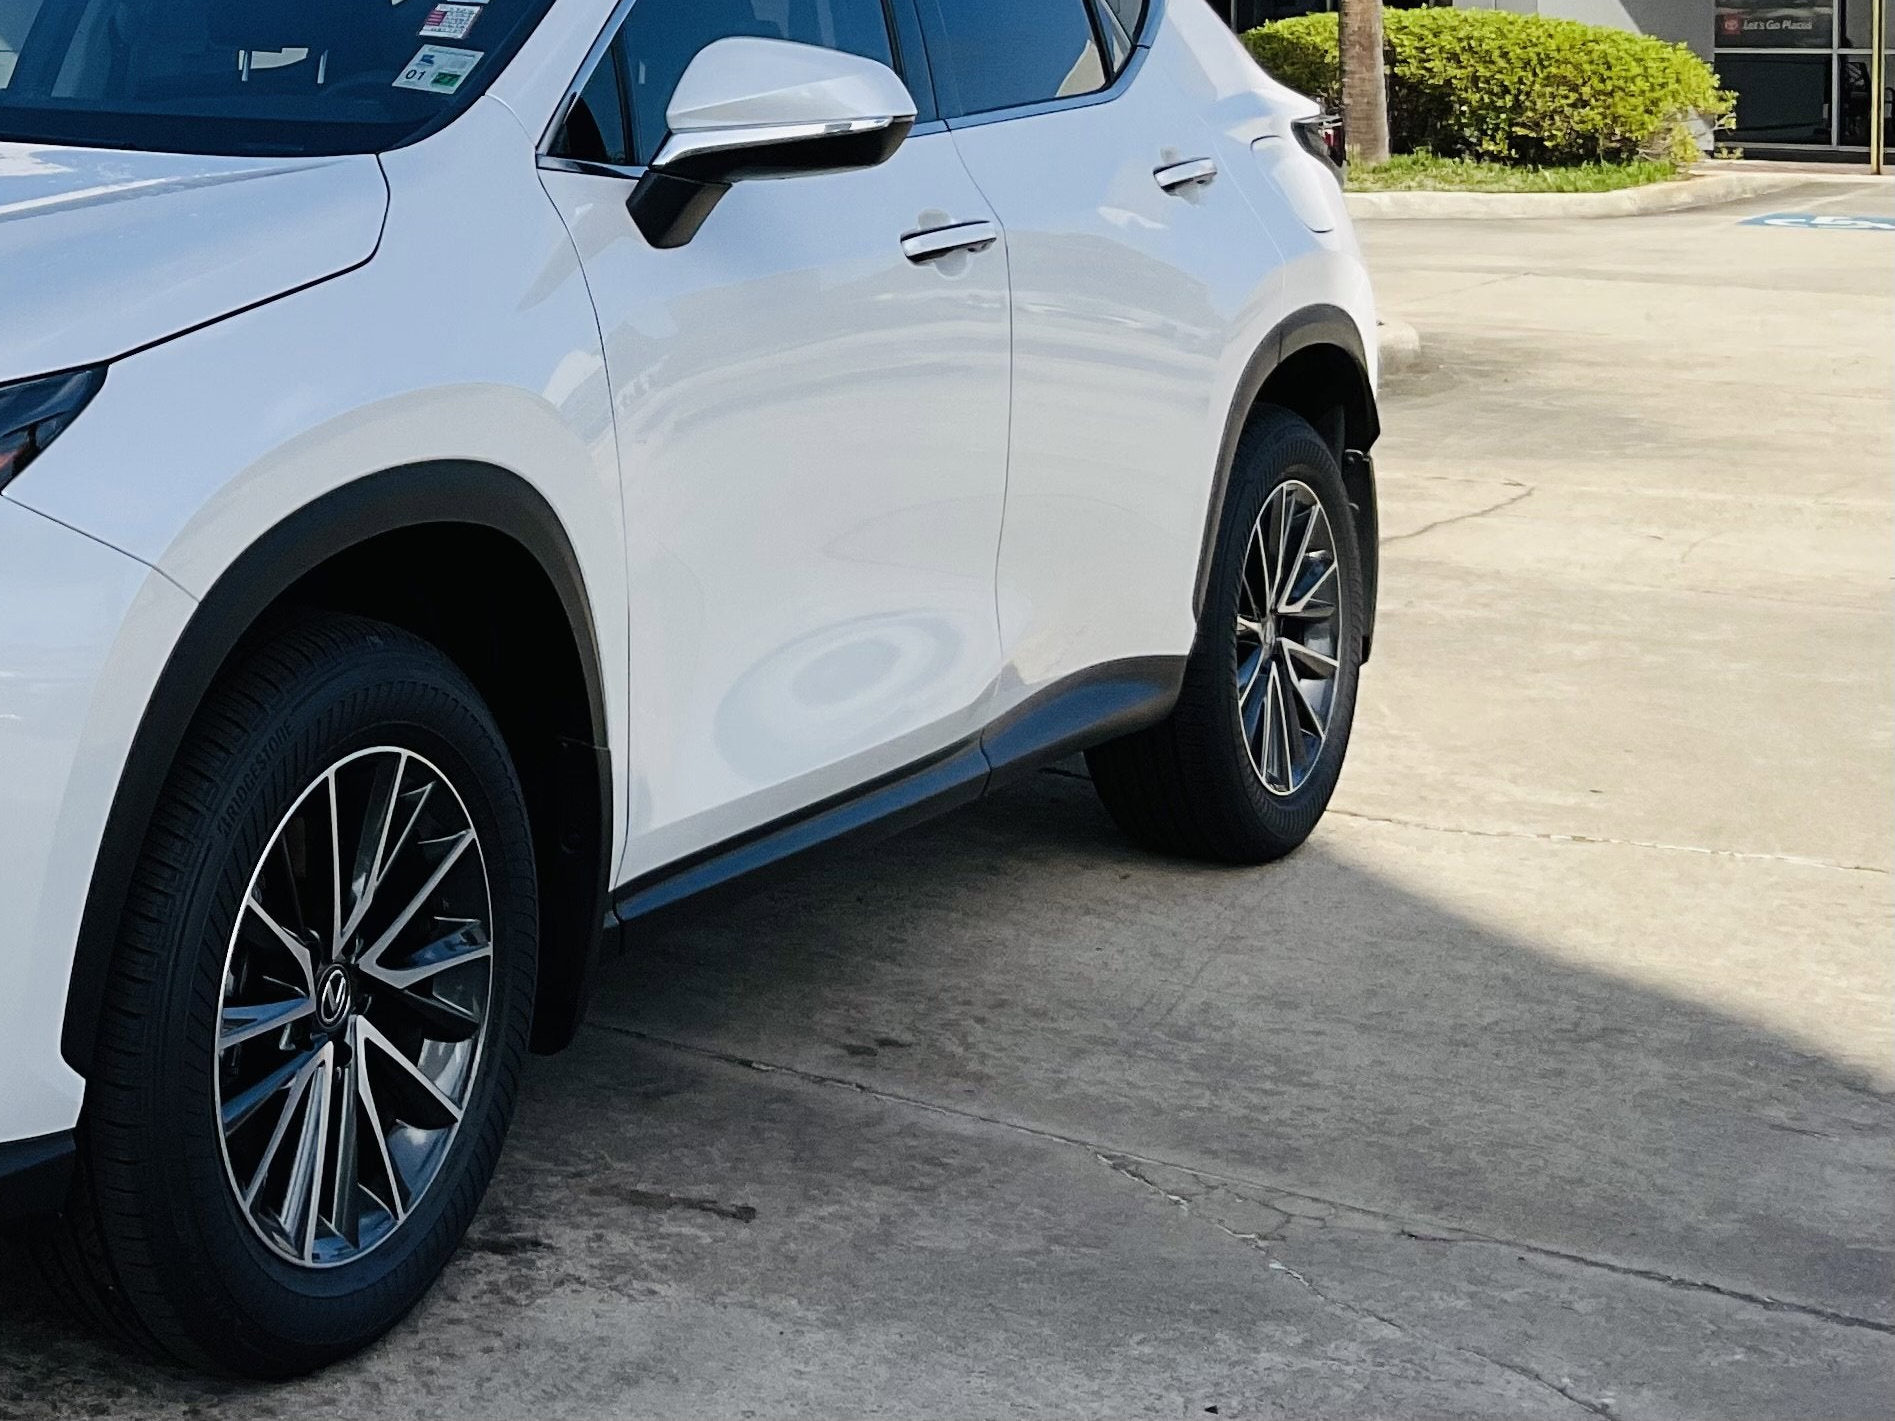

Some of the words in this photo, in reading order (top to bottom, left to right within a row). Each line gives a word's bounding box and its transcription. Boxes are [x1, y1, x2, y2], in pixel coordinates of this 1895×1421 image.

[1766, 19, 1780, 30] Go
[405, 69, 426, 80] 01
[216, 718, 294, 835] BRIDGESTONE
